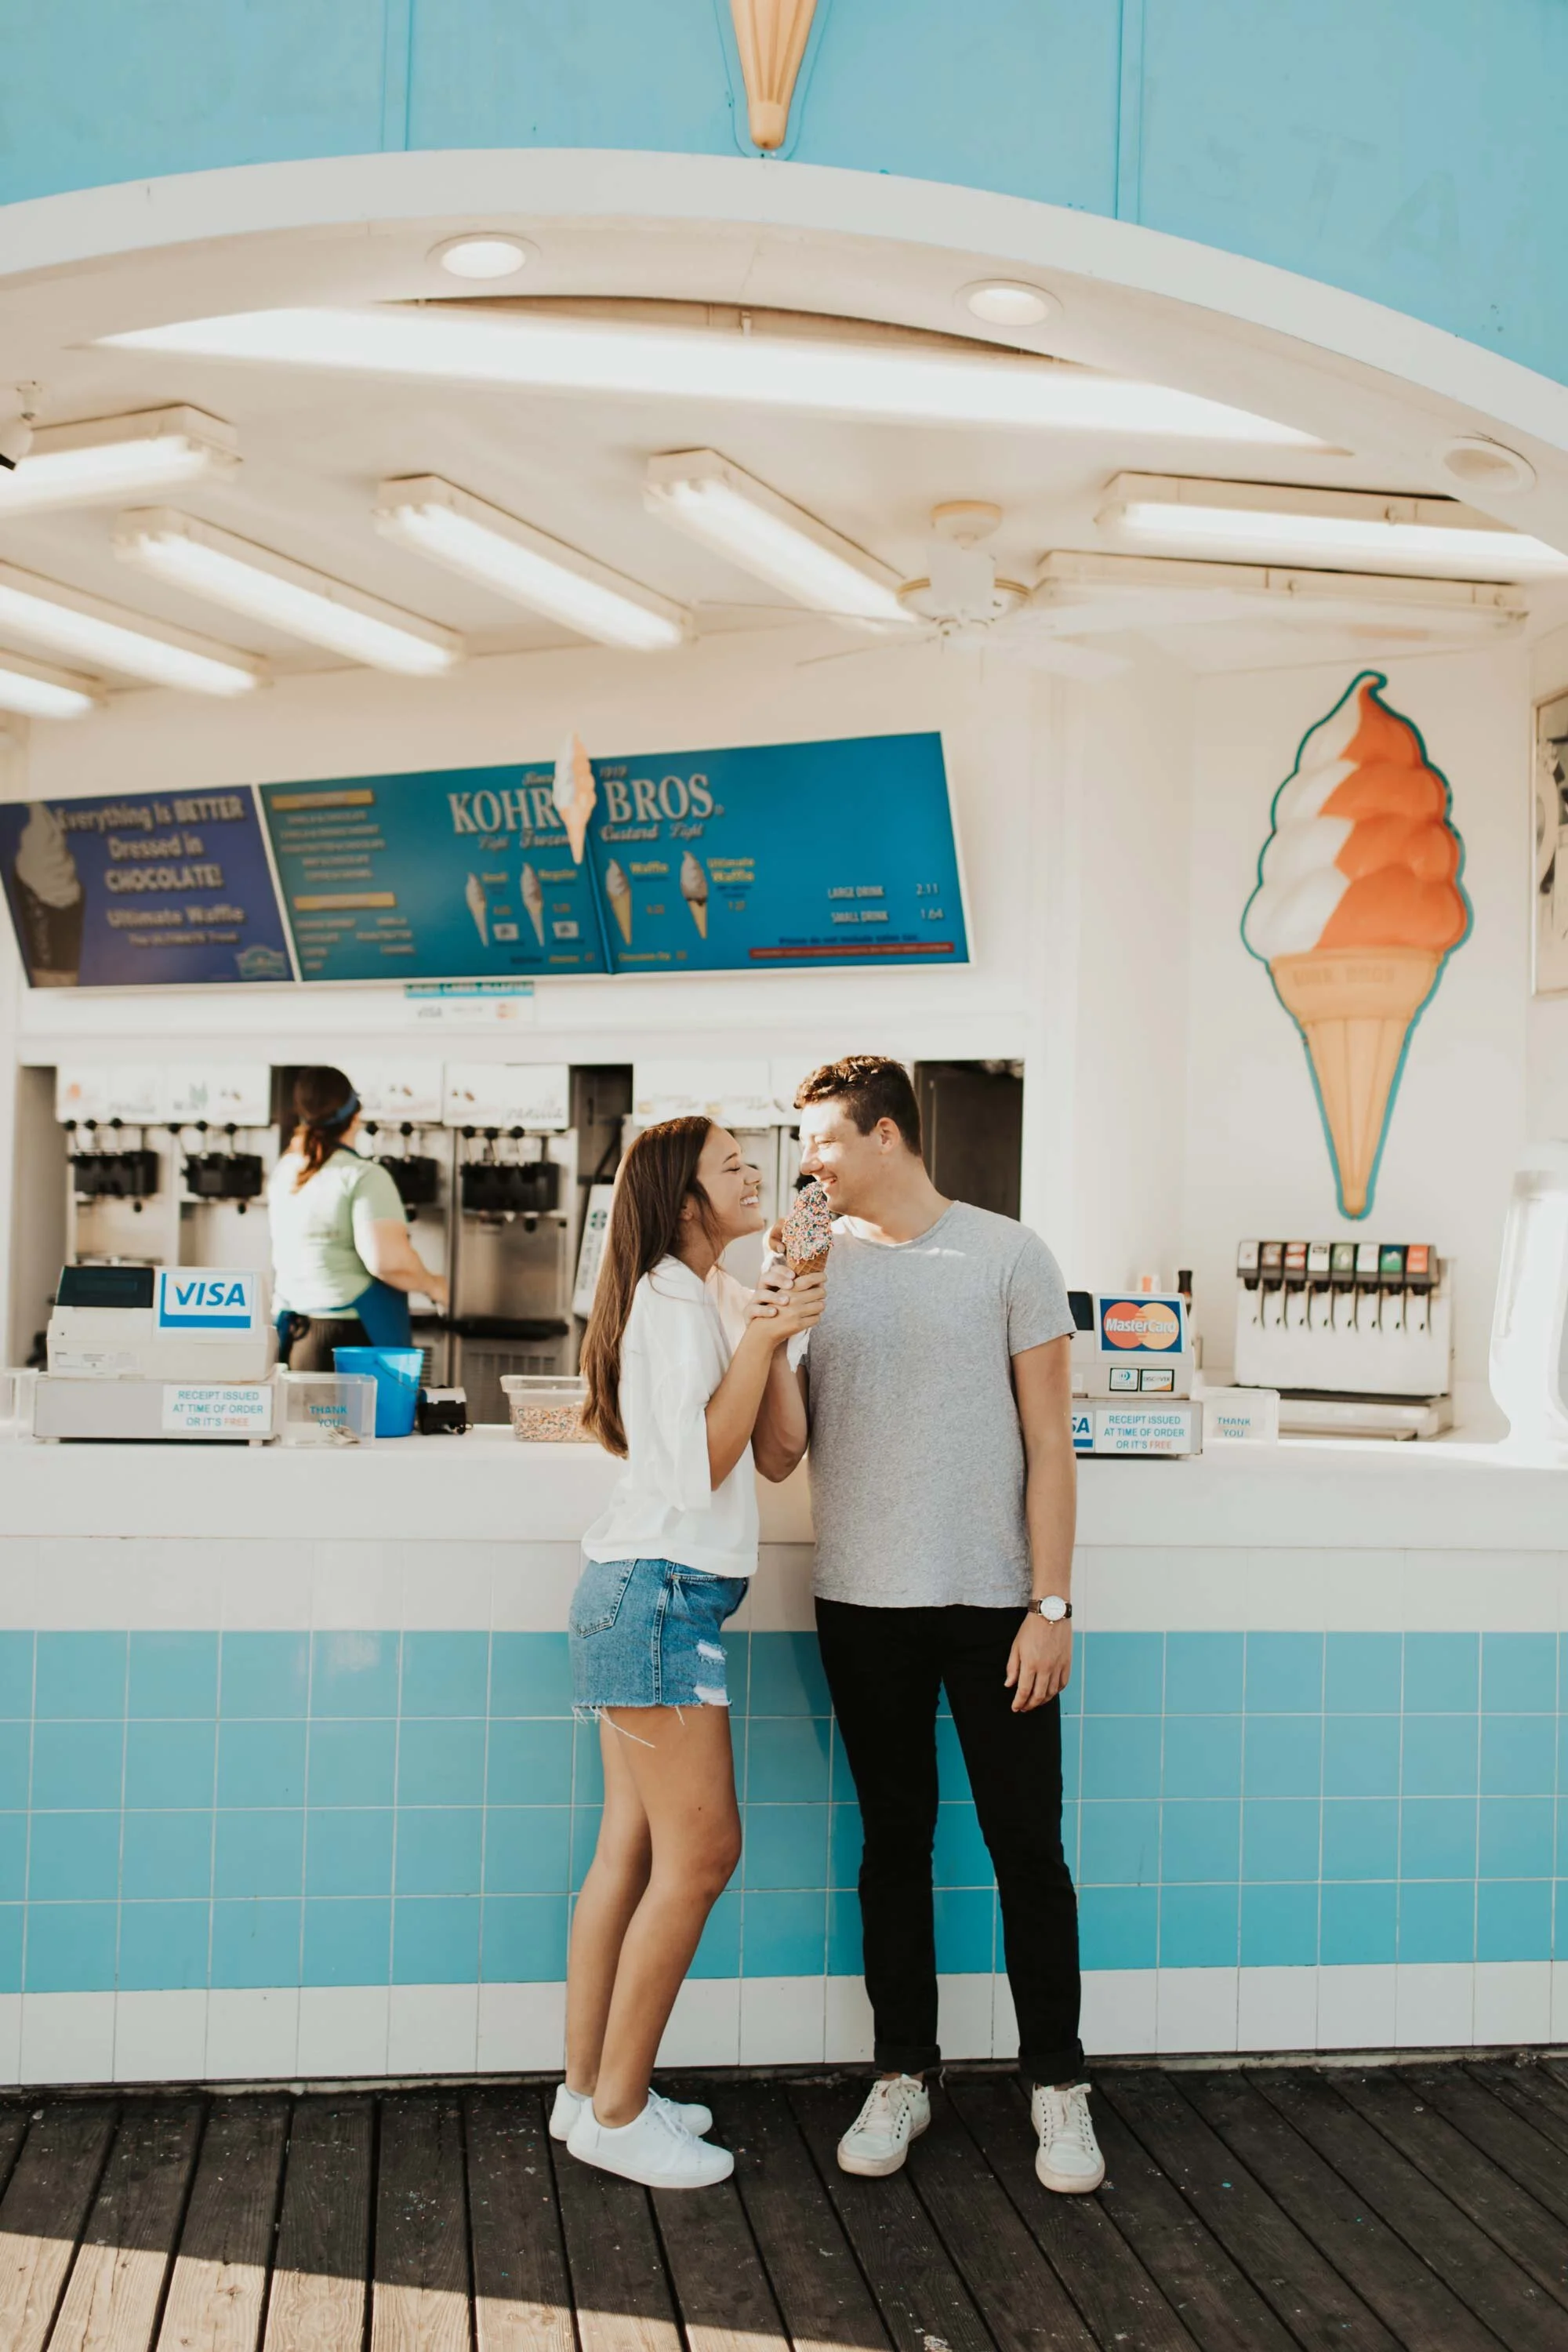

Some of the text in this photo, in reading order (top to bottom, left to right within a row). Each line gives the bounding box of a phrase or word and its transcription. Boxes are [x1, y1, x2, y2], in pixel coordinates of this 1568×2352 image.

[173, 795, 244, 822] BETTER
[828, 884, 938, 898] LARGE DRINK 2.11
[831, 912, 858, 924] SMALL
[861, 910, 888, 922] DRINK
[174, 1281, 245, 1306] VISA
[1105, 1318, 1175, 1333] MasterCard
[178, 1391, 259, 1401] RECEIPT ISSUED
[187, 1404, 211, 1413] TIME
[213, 1404, 226, 1414] OF
[229, 1404, 263, 1414] ORDER
[309, 1406, 347, 1414] THANK
[186, 1417, 249, 1427] OR IT'S FREE
[1109, 1415, 1180, 1424] RECEIPT ISSUED
[1218, 1417, 1250, 1425] THANK
[1131, 1440, 1148, 1449] IT'S
[1149, 1440, 1171, 1449] FREE
